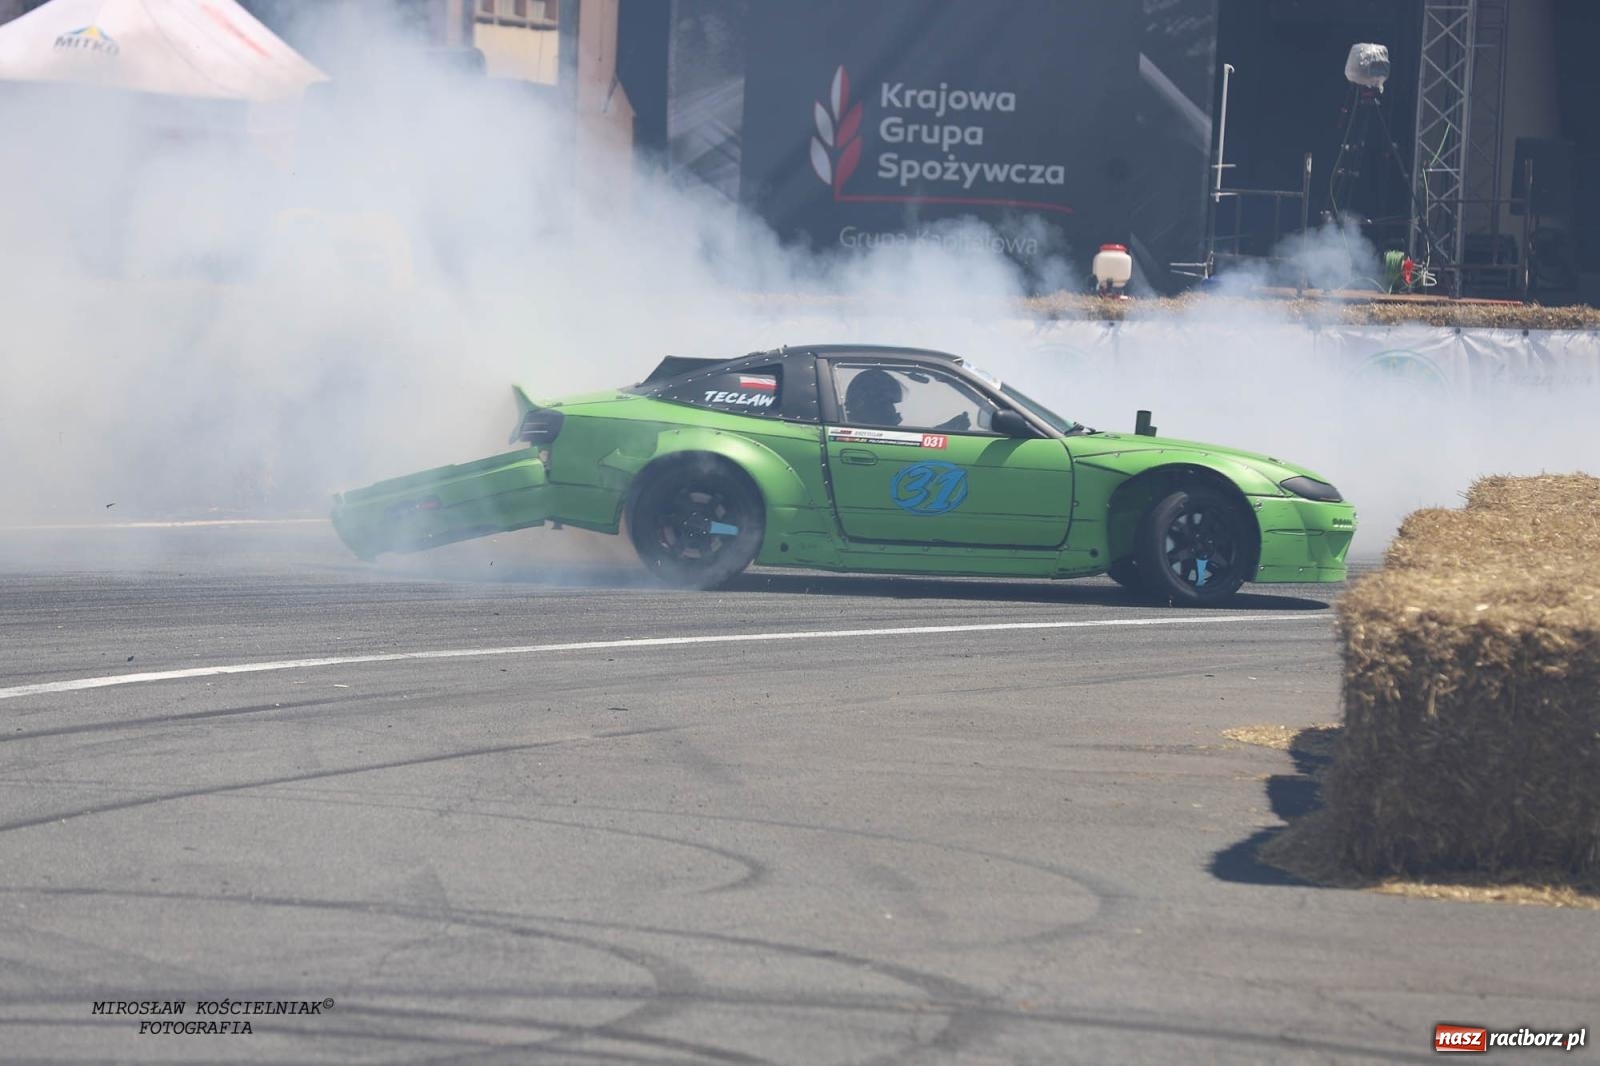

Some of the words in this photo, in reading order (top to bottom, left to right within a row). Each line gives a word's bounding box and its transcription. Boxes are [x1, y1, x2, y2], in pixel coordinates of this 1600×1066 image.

[54, 36, 119, 56] MITKO
[881, 82, 1016, 117] Krajowa
[880, 117, 983, 151] Grupa
[878, 153, 1065, 188] Spożywcza
[840, 226, 907, 250] Grupa
[704, 390, 775, 407] TECŁAW
[923, 434, 945, 448] 031
[897, 464, 967, 510] 31
